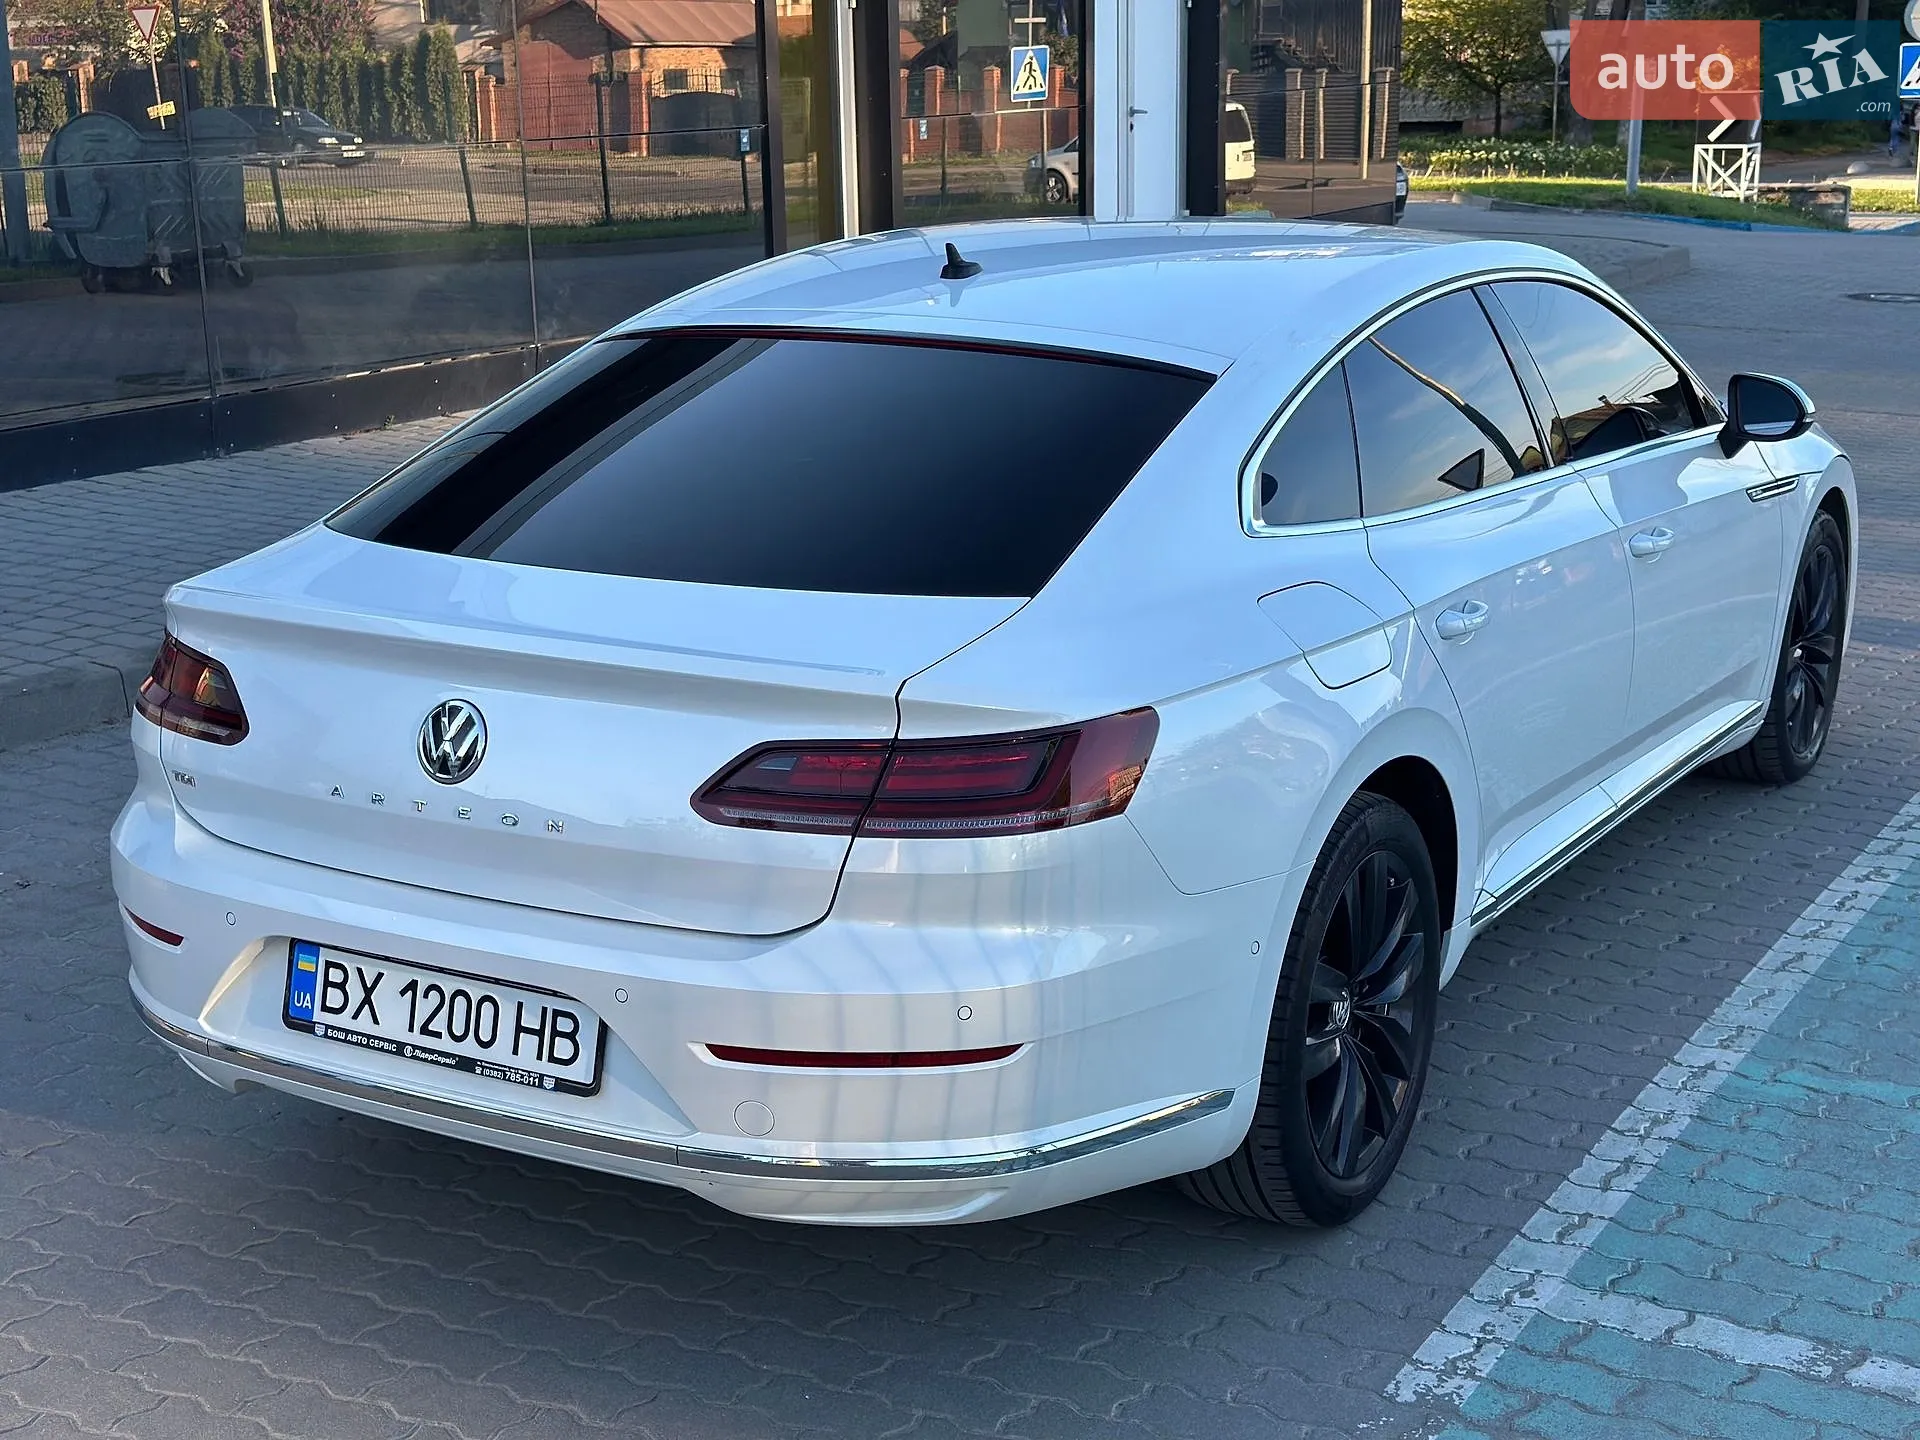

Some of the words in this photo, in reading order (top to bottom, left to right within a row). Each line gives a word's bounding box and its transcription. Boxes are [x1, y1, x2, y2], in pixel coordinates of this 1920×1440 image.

[330, 784, 565, 833] ARTEON
[294, 990, 312, 1010] UA
[320, 959, 385, 1026] BX
[399, 978, 500, 1050] 1200
[512, 1000, 581, 1067] HB
[327, 1028, 346, 1040] БОШ
[346, 1034, 368, 1045] АВТО
[369, 1038, 397, 1052] СЕРВІС
[505, 1072, 540, 1086] 785-011
